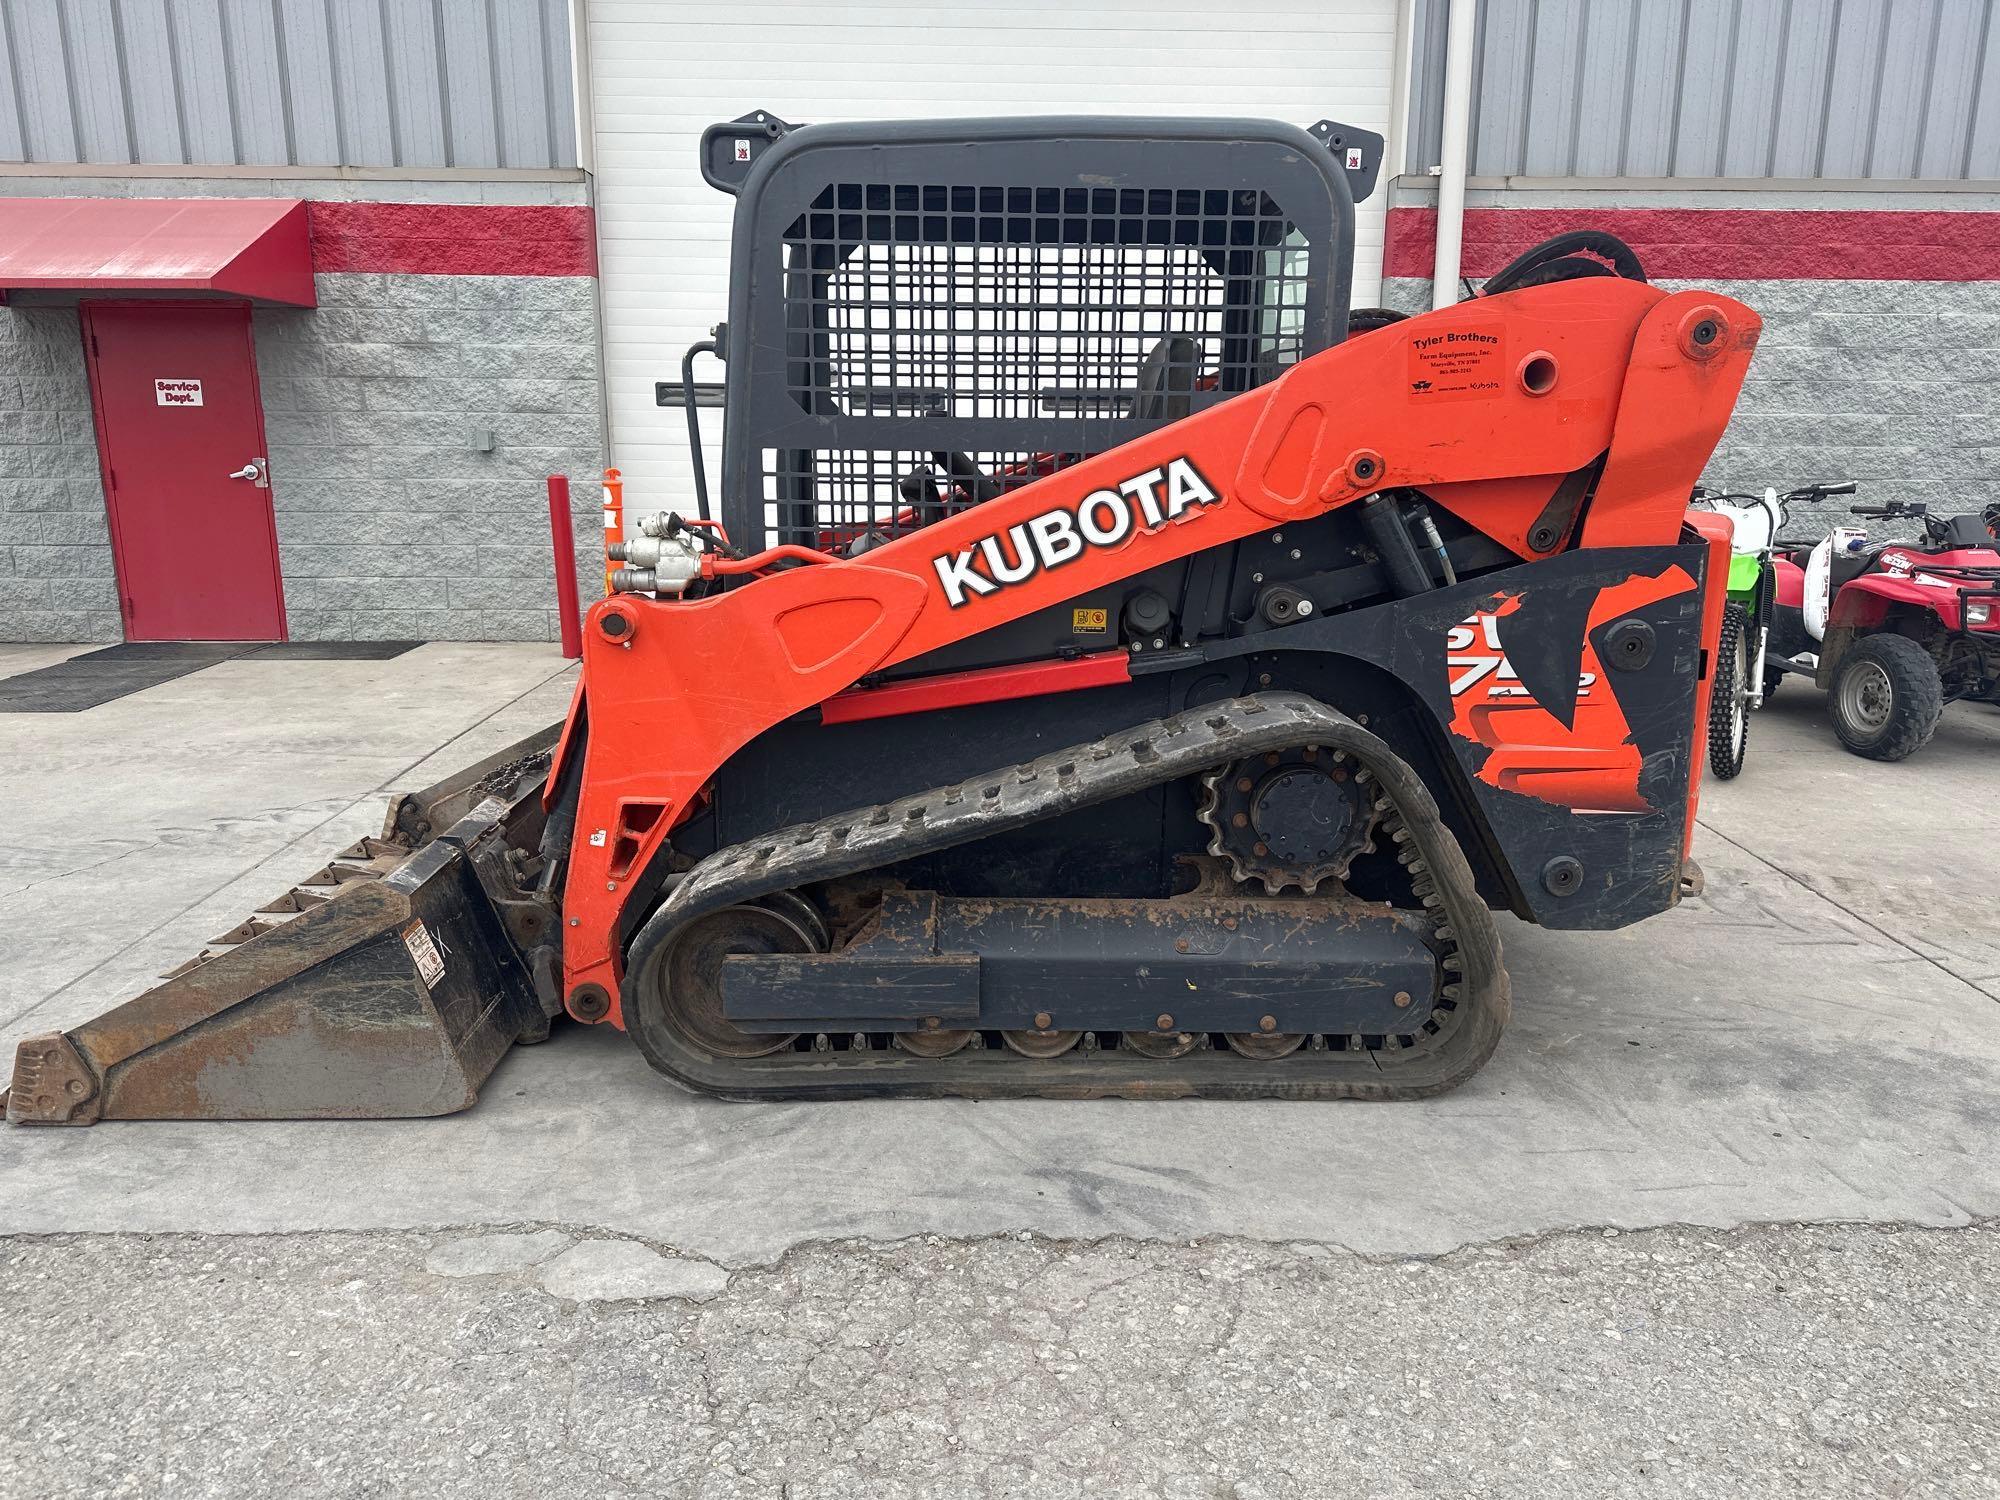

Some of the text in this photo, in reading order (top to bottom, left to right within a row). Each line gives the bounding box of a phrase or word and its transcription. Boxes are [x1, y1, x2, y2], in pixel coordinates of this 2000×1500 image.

[1413, 332, 1498, 349] Tyler Brothers
[157, 381, 200, 391] Service
[1470, 382, 1499, 390] Kubota
[165, 393, 194, 404] Dept.
[933, 456, 1216, 607] KUBOTA
